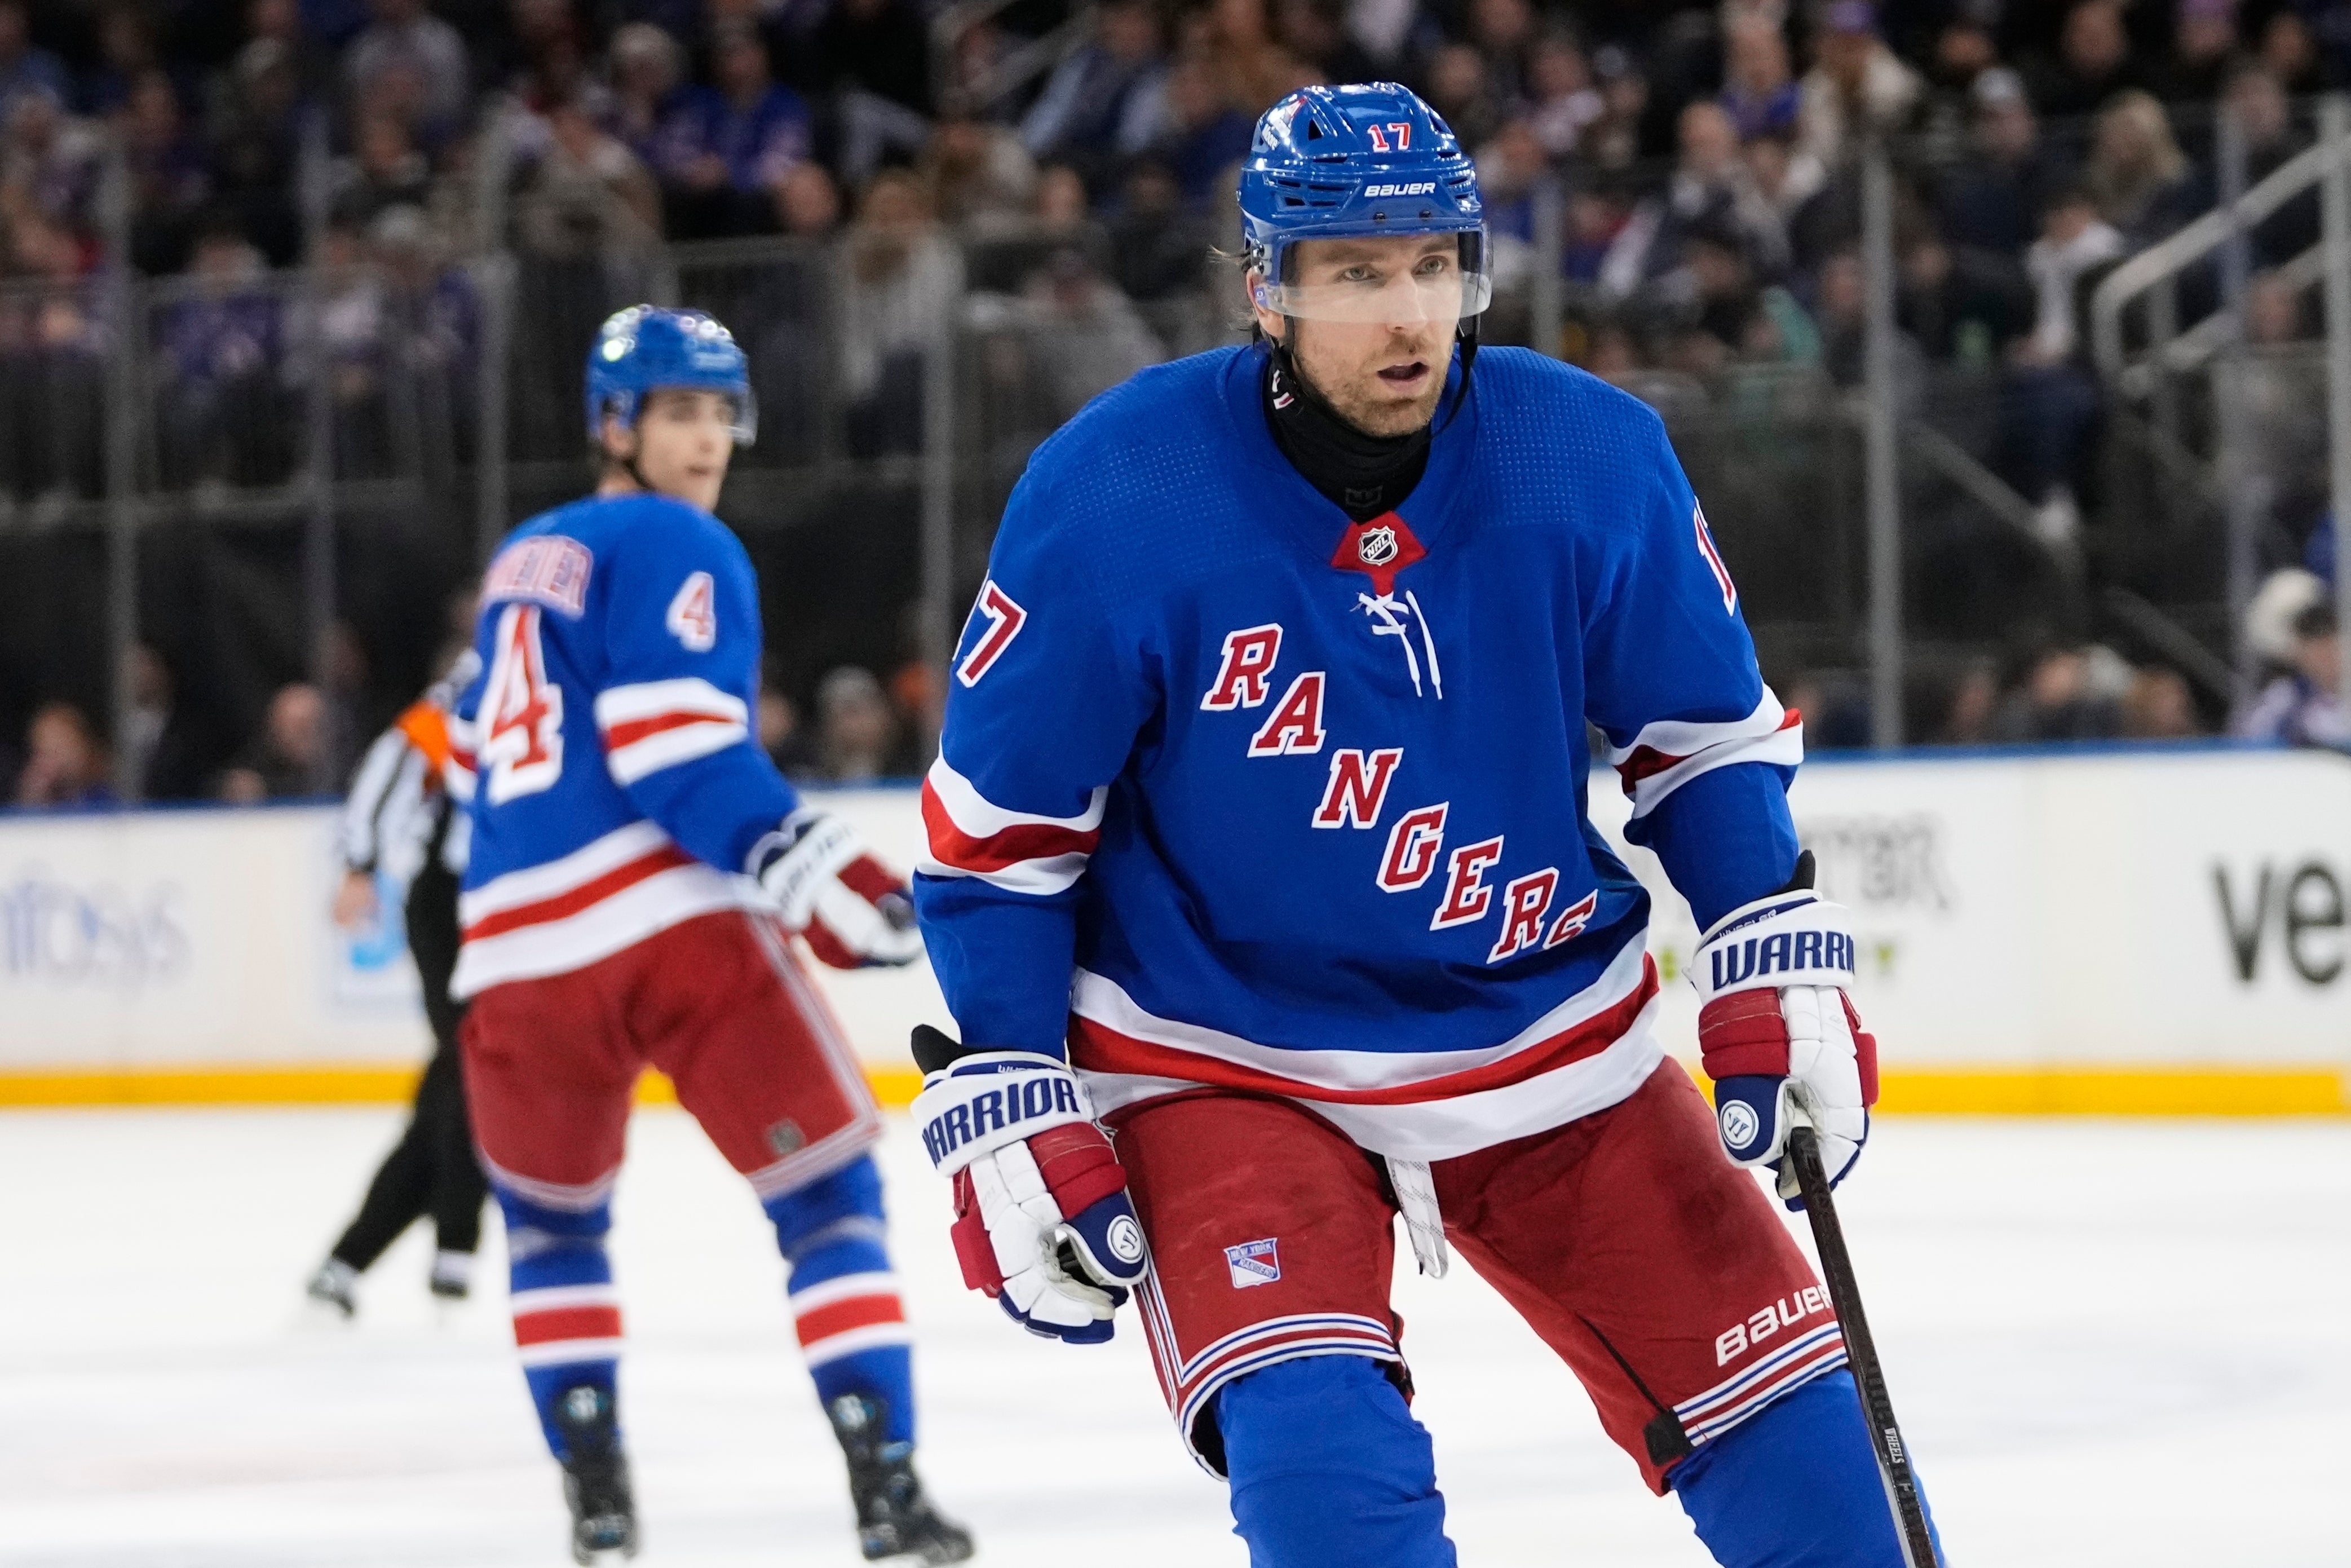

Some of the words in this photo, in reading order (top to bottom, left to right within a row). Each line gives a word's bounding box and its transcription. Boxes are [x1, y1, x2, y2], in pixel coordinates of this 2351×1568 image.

[1368, 122, 1411, 152] 17
[1364, 182, 1436, 197] BAUER
[1367, 536, 1389, 558] NHL
[666, 571, 716, 652] 4
[952, 568, 1028, 688] 7
[479, 602, 564, 806] 4
[1250, 1242, 1272, 1254] YORK
[1240, 1258, 1276, 1279] RANGERS
[1884, 1428, 1905, 1464] WHEELS
